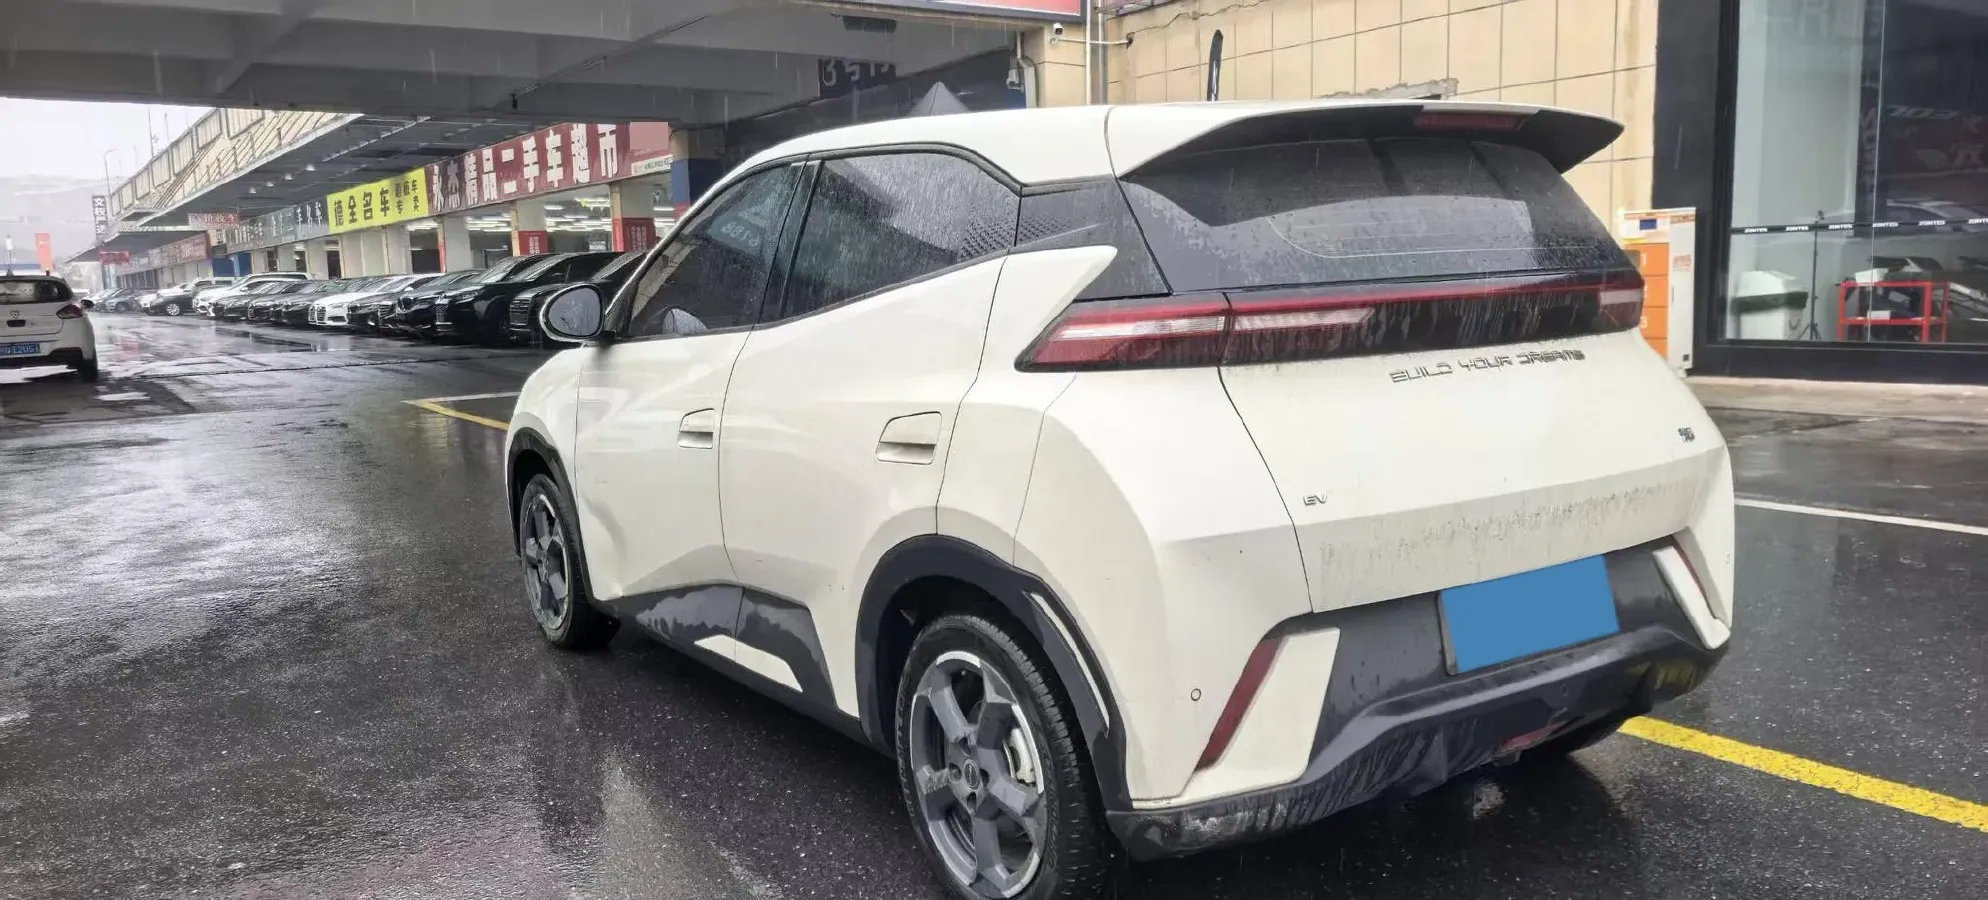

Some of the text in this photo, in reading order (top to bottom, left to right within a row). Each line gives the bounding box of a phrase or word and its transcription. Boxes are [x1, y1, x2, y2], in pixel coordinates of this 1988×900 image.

[1389, 348, 1587, 384] BUILD YOUR DREAMS
[1302, 493, 1328, 507] EV
